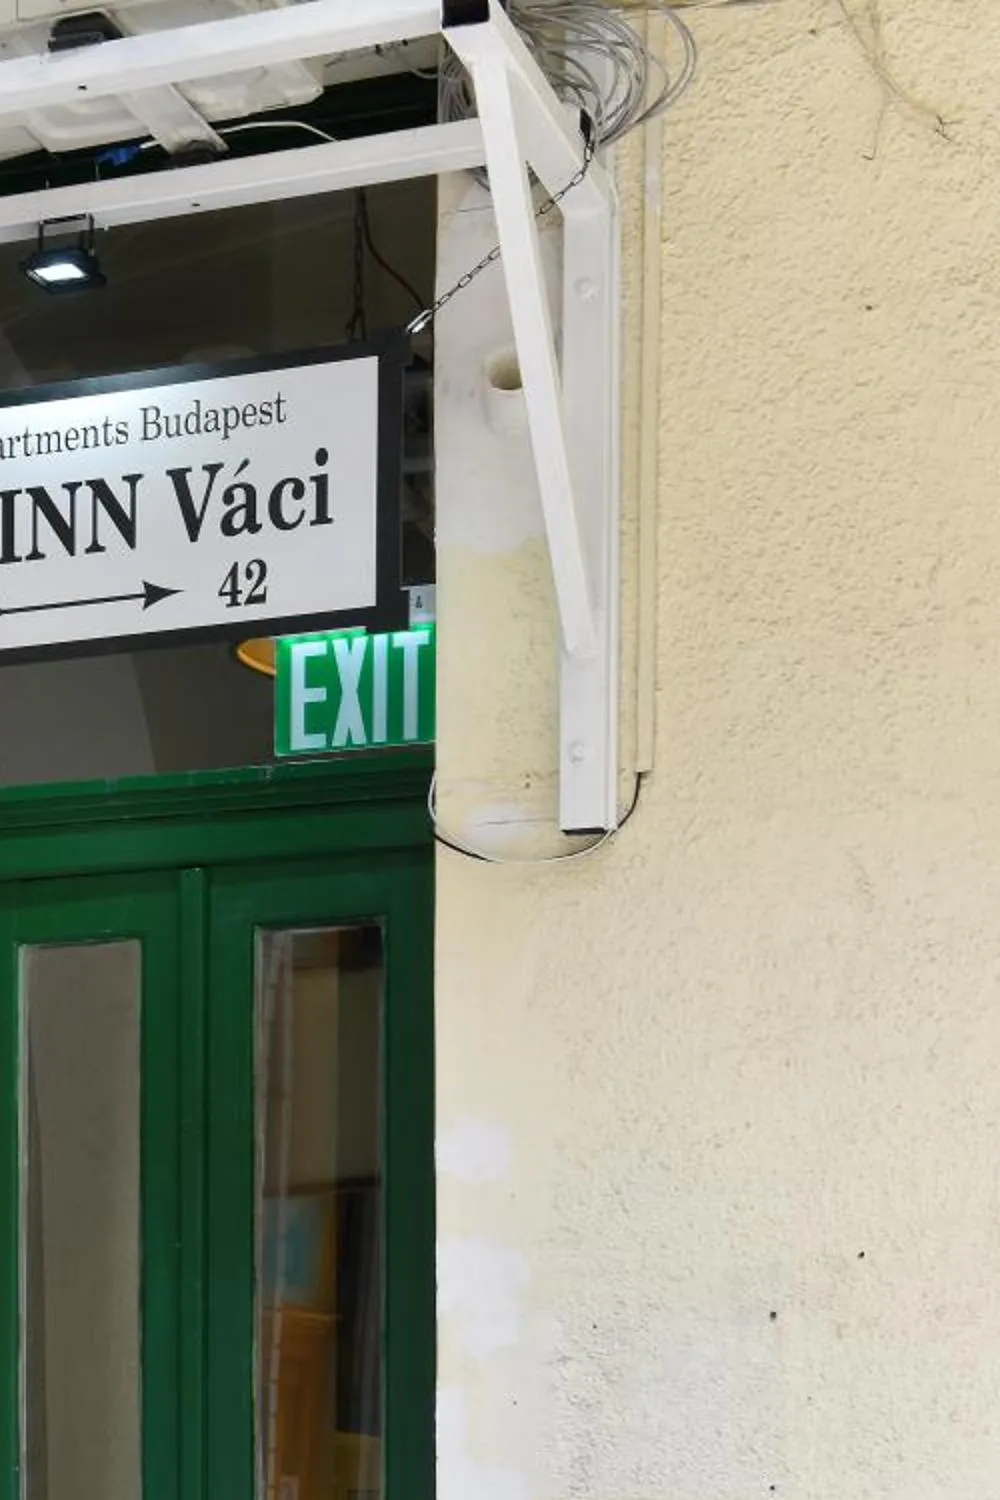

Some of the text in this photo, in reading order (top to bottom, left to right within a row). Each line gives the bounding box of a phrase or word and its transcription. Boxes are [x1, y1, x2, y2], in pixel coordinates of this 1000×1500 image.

[140, 391, 287, 441] Budapest
[166, 448, 334, 543] Váci
[218, 559, 267, 608] 42
[290, 632, 430, 751] EXIT
